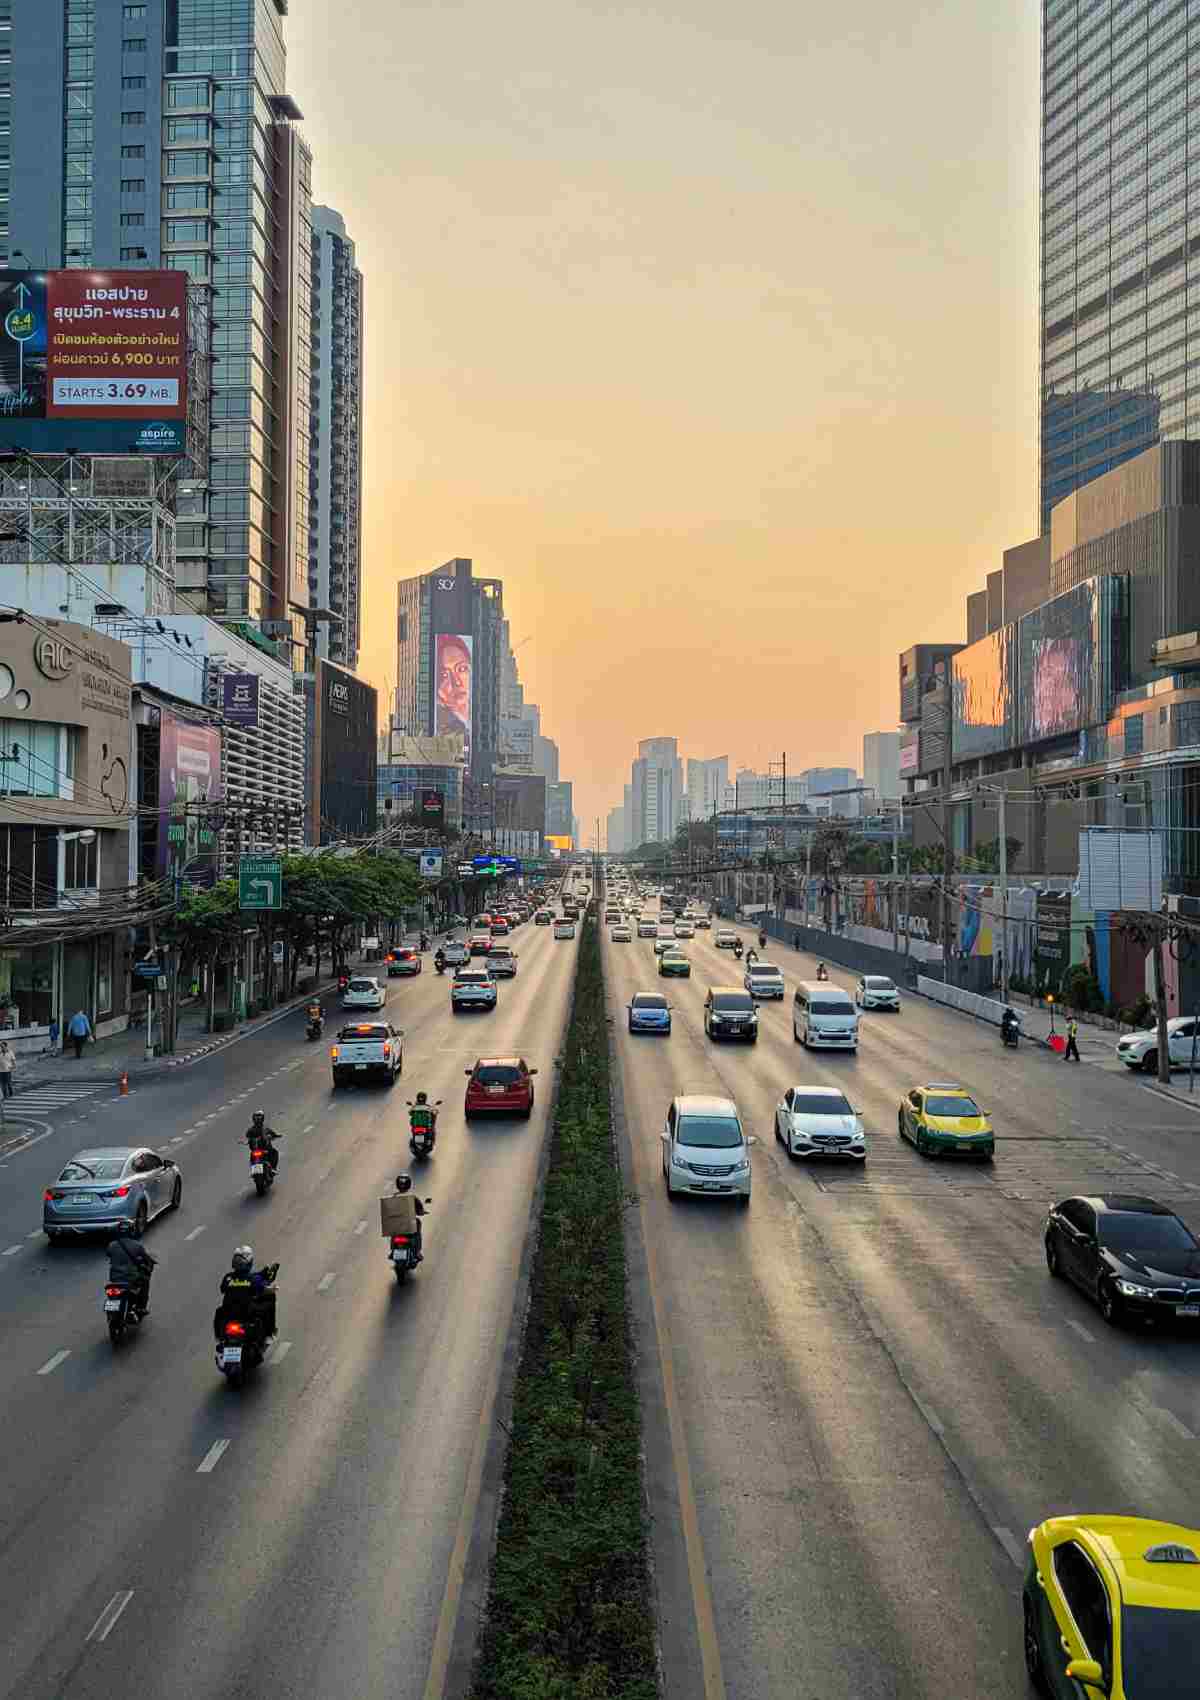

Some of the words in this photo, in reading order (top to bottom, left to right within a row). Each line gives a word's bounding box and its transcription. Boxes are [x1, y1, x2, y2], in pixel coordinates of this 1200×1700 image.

[85, 286, 148, 300] แอสปาย
[170, 306, 180, 318] 4
[112, 353, 153, 366] 6,900
[59, 387, 105, 398] STARTS
[107, 383, 147, 398] 3.69
[140, 429, 175, 440] aspire
